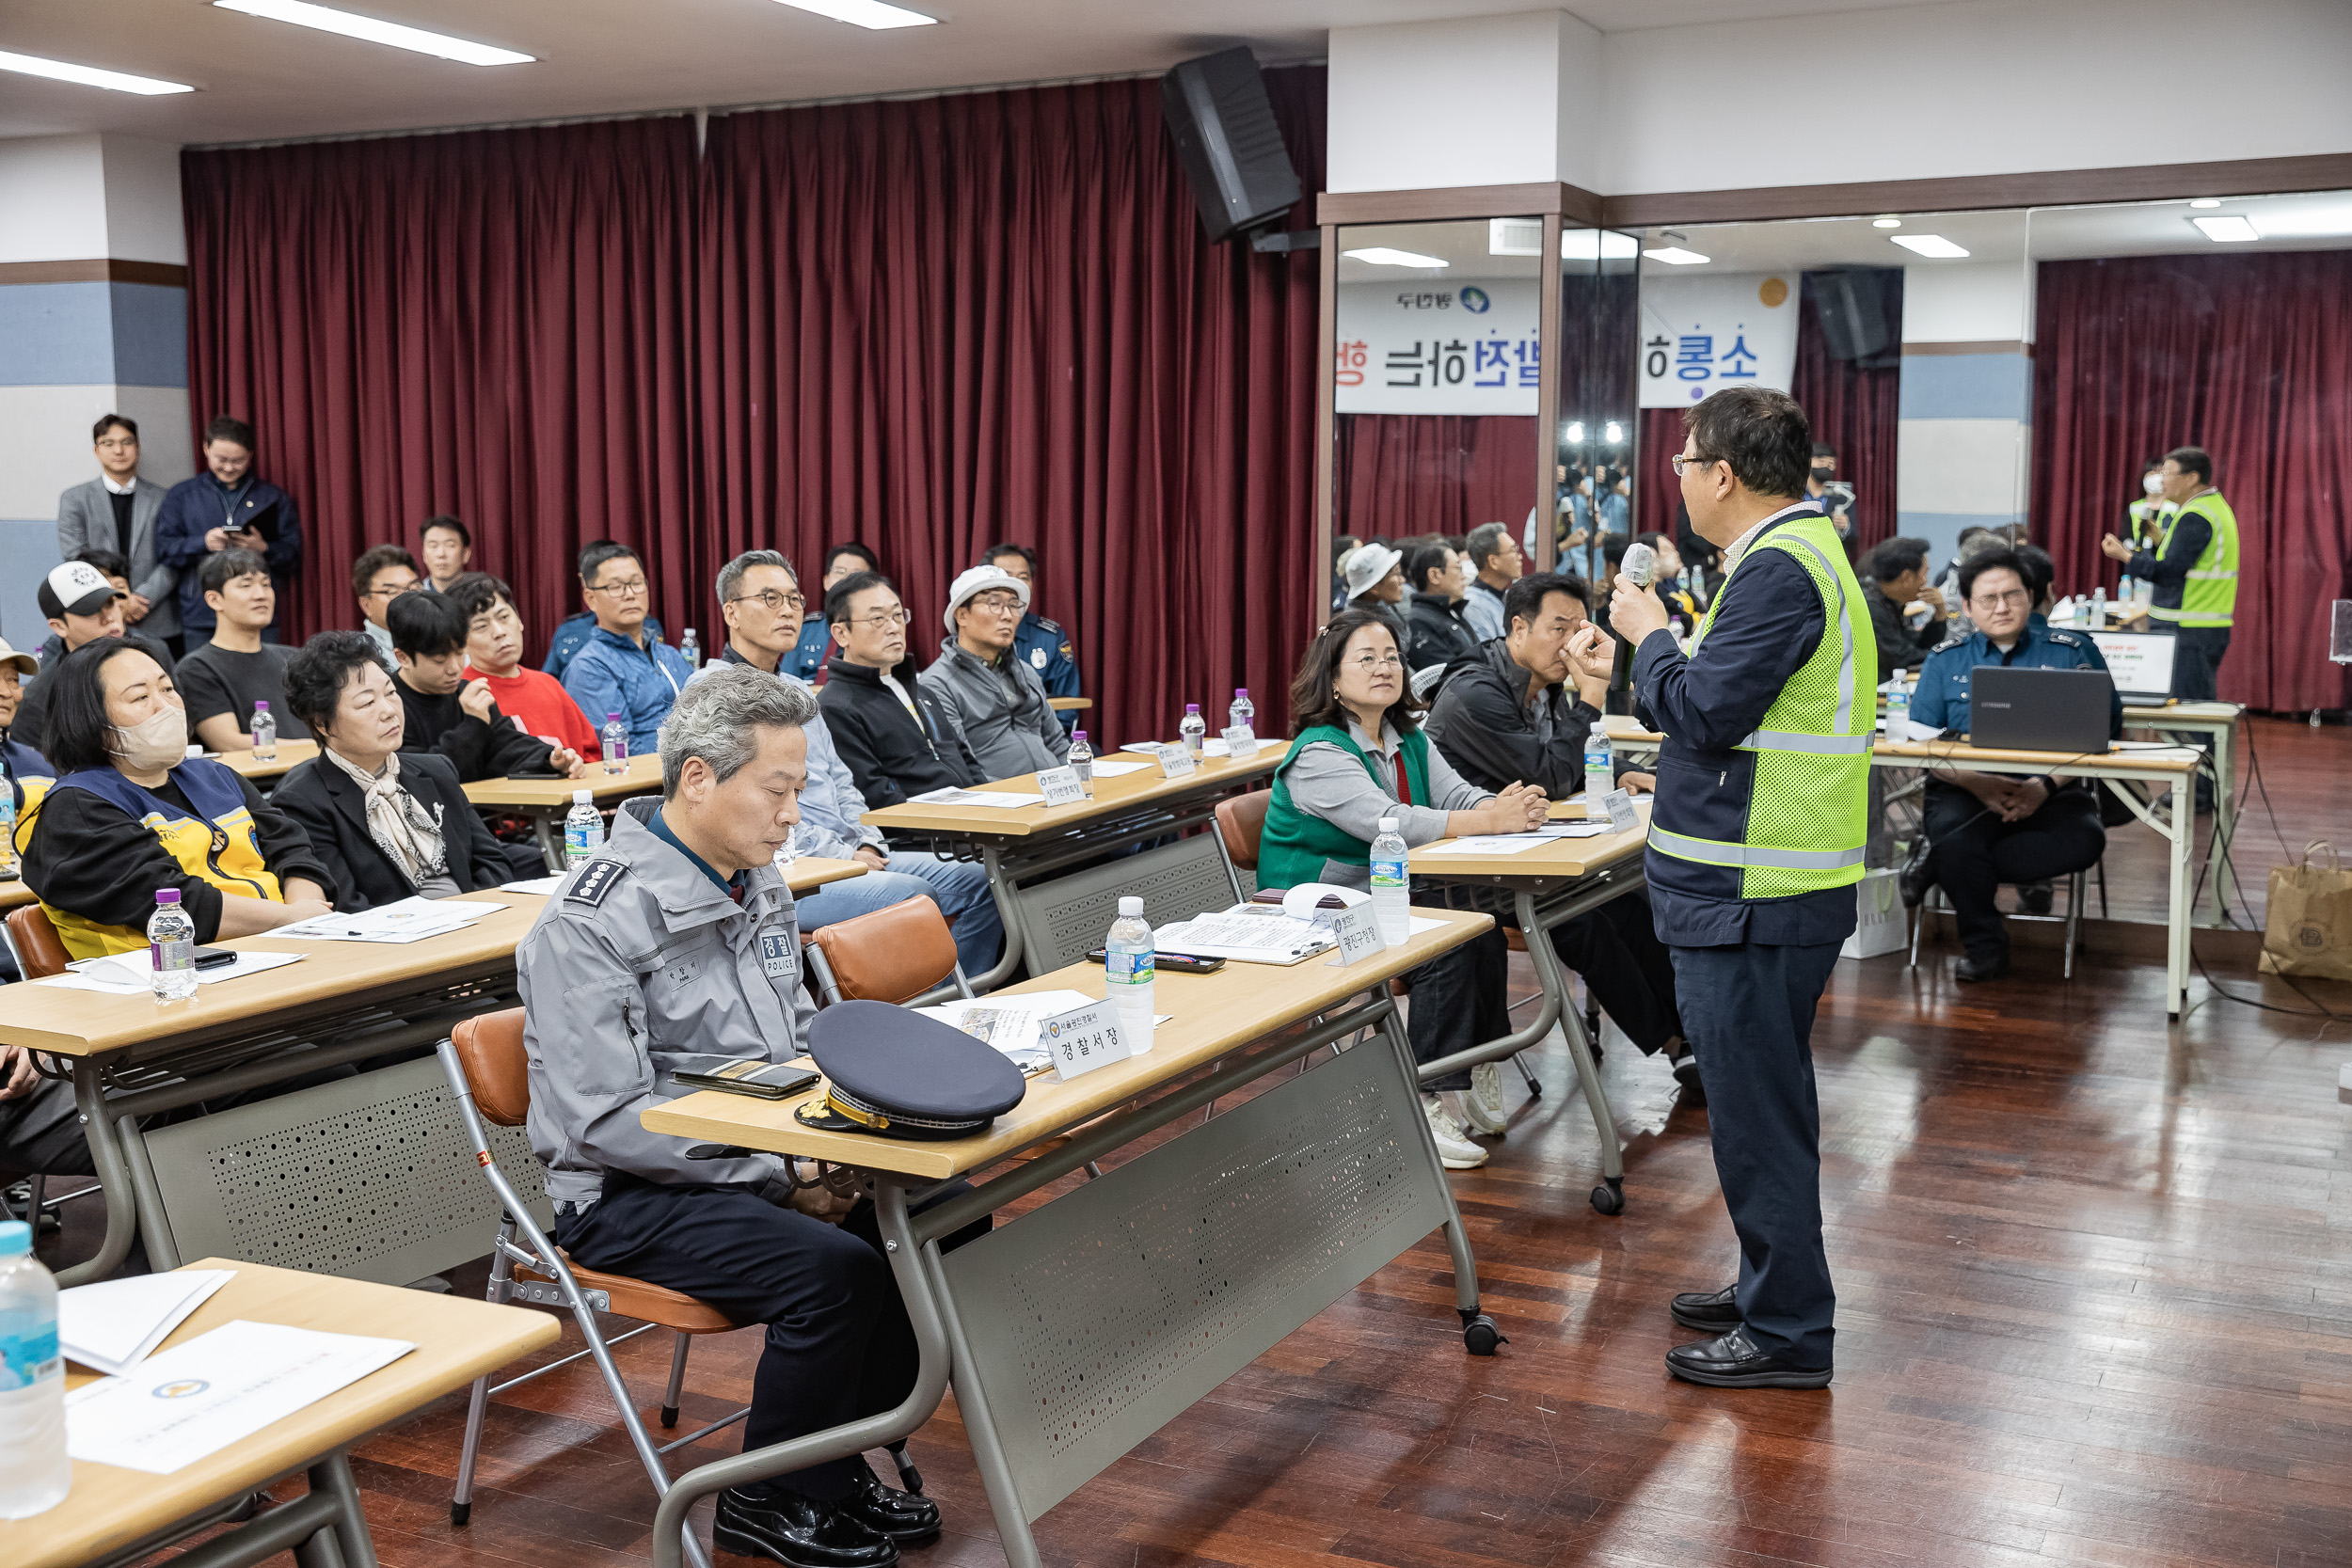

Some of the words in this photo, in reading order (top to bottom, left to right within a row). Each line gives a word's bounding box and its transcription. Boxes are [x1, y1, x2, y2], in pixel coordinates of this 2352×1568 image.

[763, 936, 789, 958] 경찰
[1343, 927, 1376, 952] 광진구청장
[768, 959, 793, 971] POLICE
[1060, 1011, 1098, 1030] 서울광진경찰서
[1061, 1026, 1118, 1061] 경찰서장
